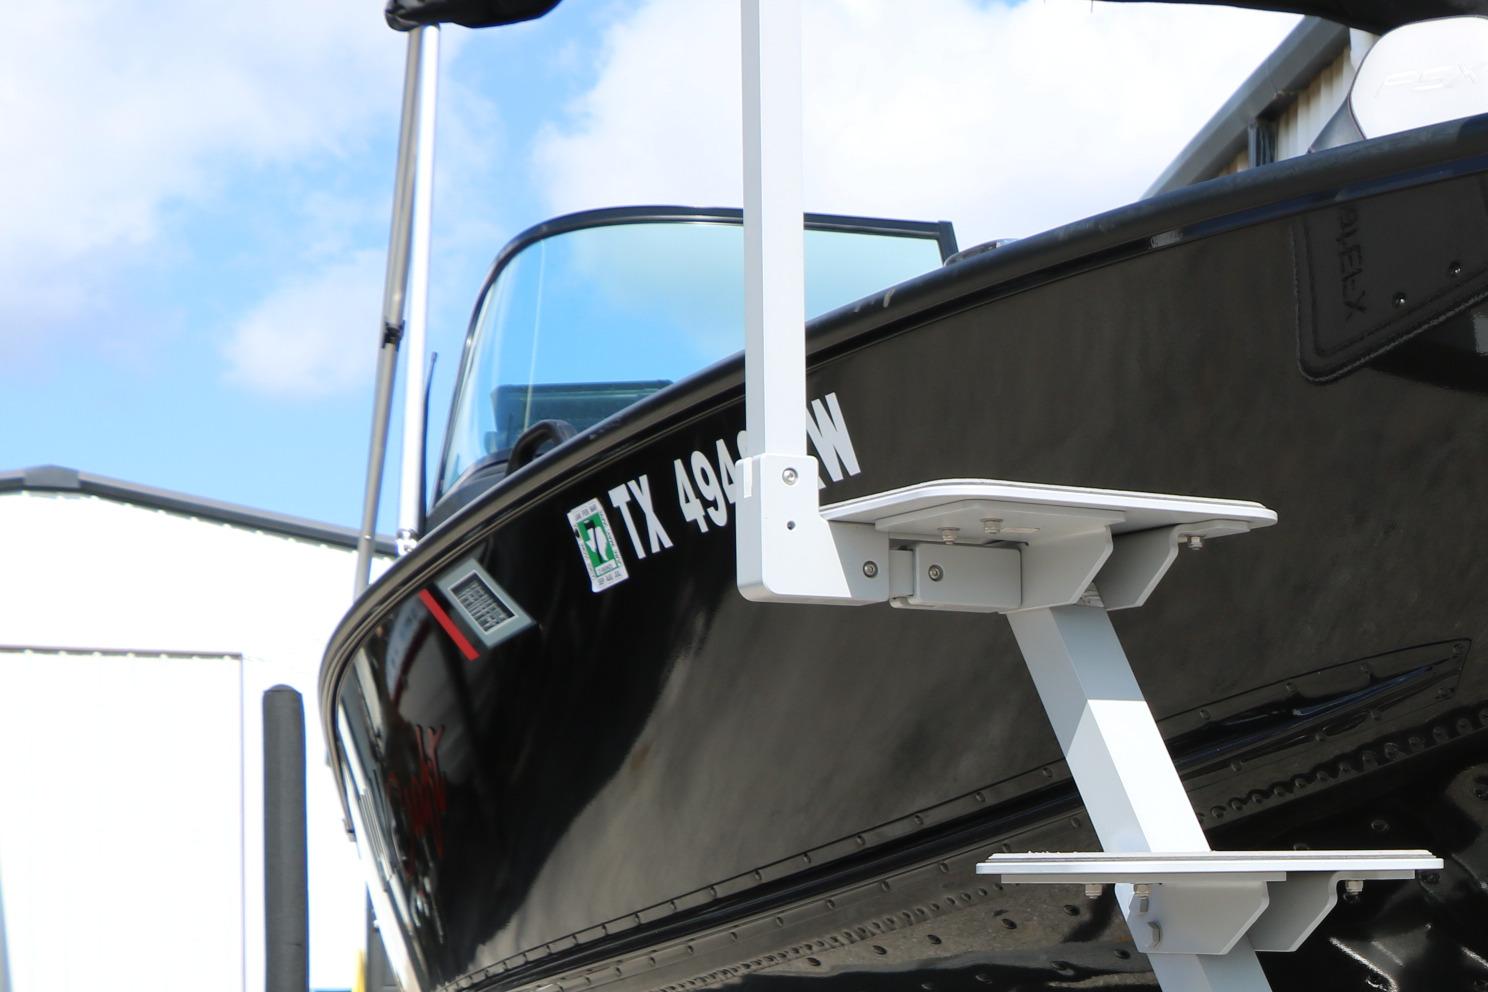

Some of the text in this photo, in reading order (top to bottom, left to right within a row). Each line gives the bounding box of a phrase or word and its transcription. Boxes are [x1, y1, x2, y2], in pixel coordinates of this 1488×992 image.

[608, 474, 673, 560] TX
[673, 430, 747, 533] 494
[806, 391, 861, 490] W
